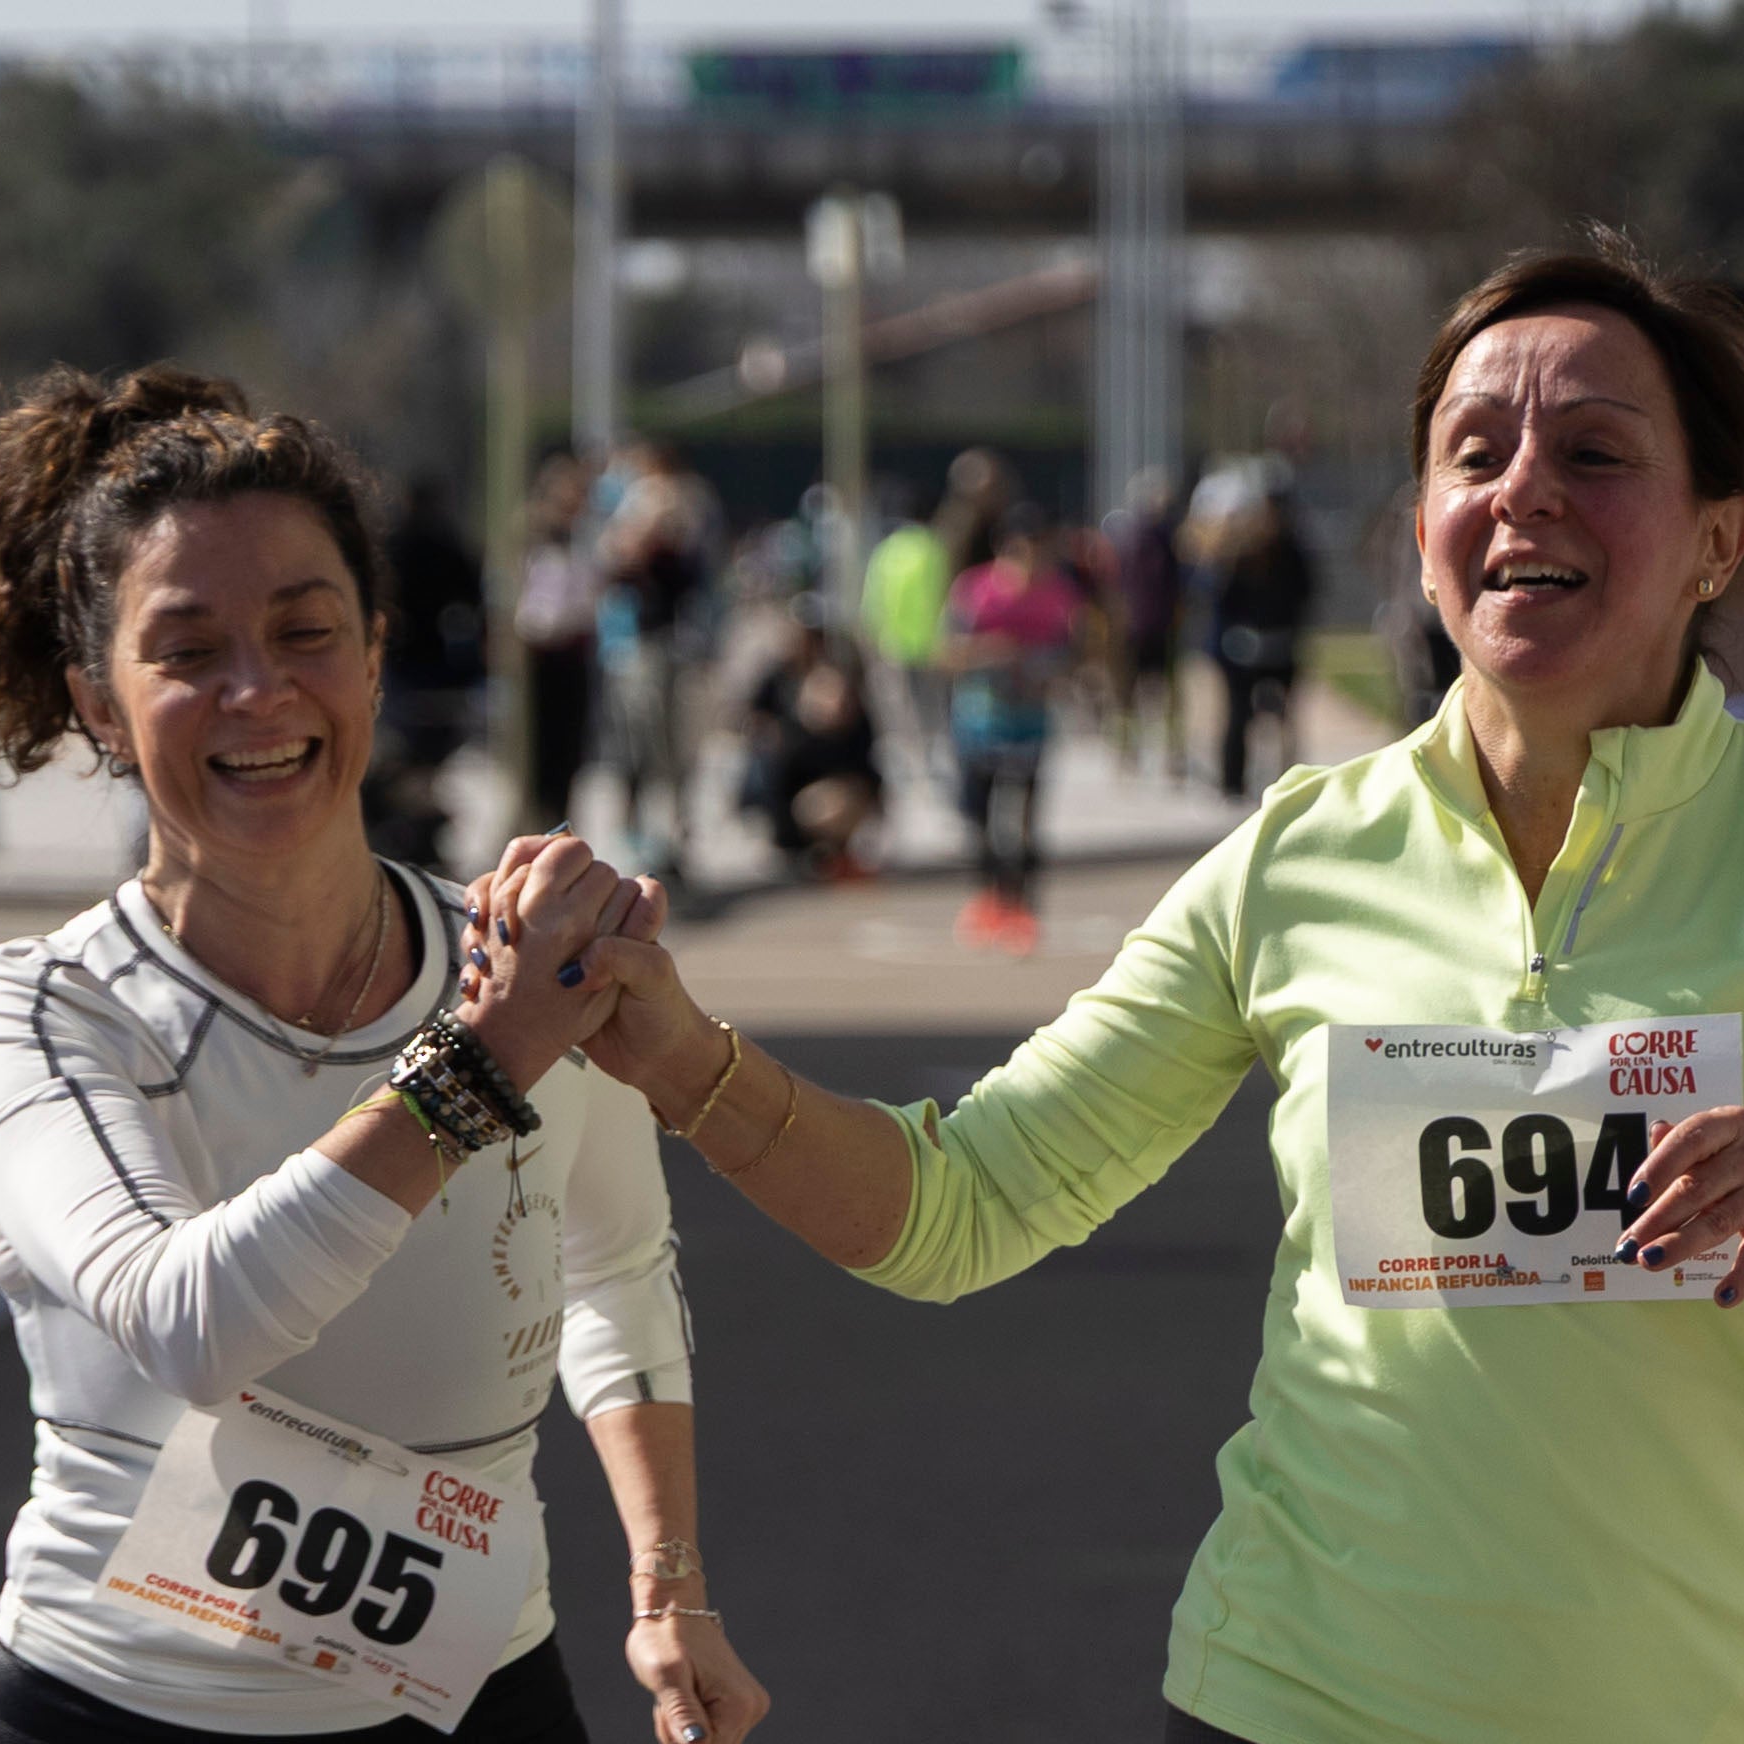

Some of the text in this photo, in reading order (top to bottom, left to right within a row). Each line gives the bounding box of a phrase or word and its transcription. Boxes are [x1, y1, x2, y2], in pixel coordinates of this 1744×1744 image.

[1384, 1039, 1536, 1059] entreculturas
[1609, 1029, 1699, 1059] CORRE
[1610, 1056, 1653, 1067] POR UNA
[1609, 1066, 1696, 1096] CAUSA
[1418, 1112, 1650, 1239] 694
[1348, 1271, 1542, 1292] INFANCIA REFUGIADA
[1378, 1253, 1509, 1273] CORRE POR LA
[424, 1471, 504, 1524] CORRE
[416, 1506, 489, 1555] CAUSA
[206, 1479, 444, 1646] 695
[107, 1575, 282, 1645] INFANCIA REFUGIADA
[145, 1573, 262, 1621] CORRE POR LA
